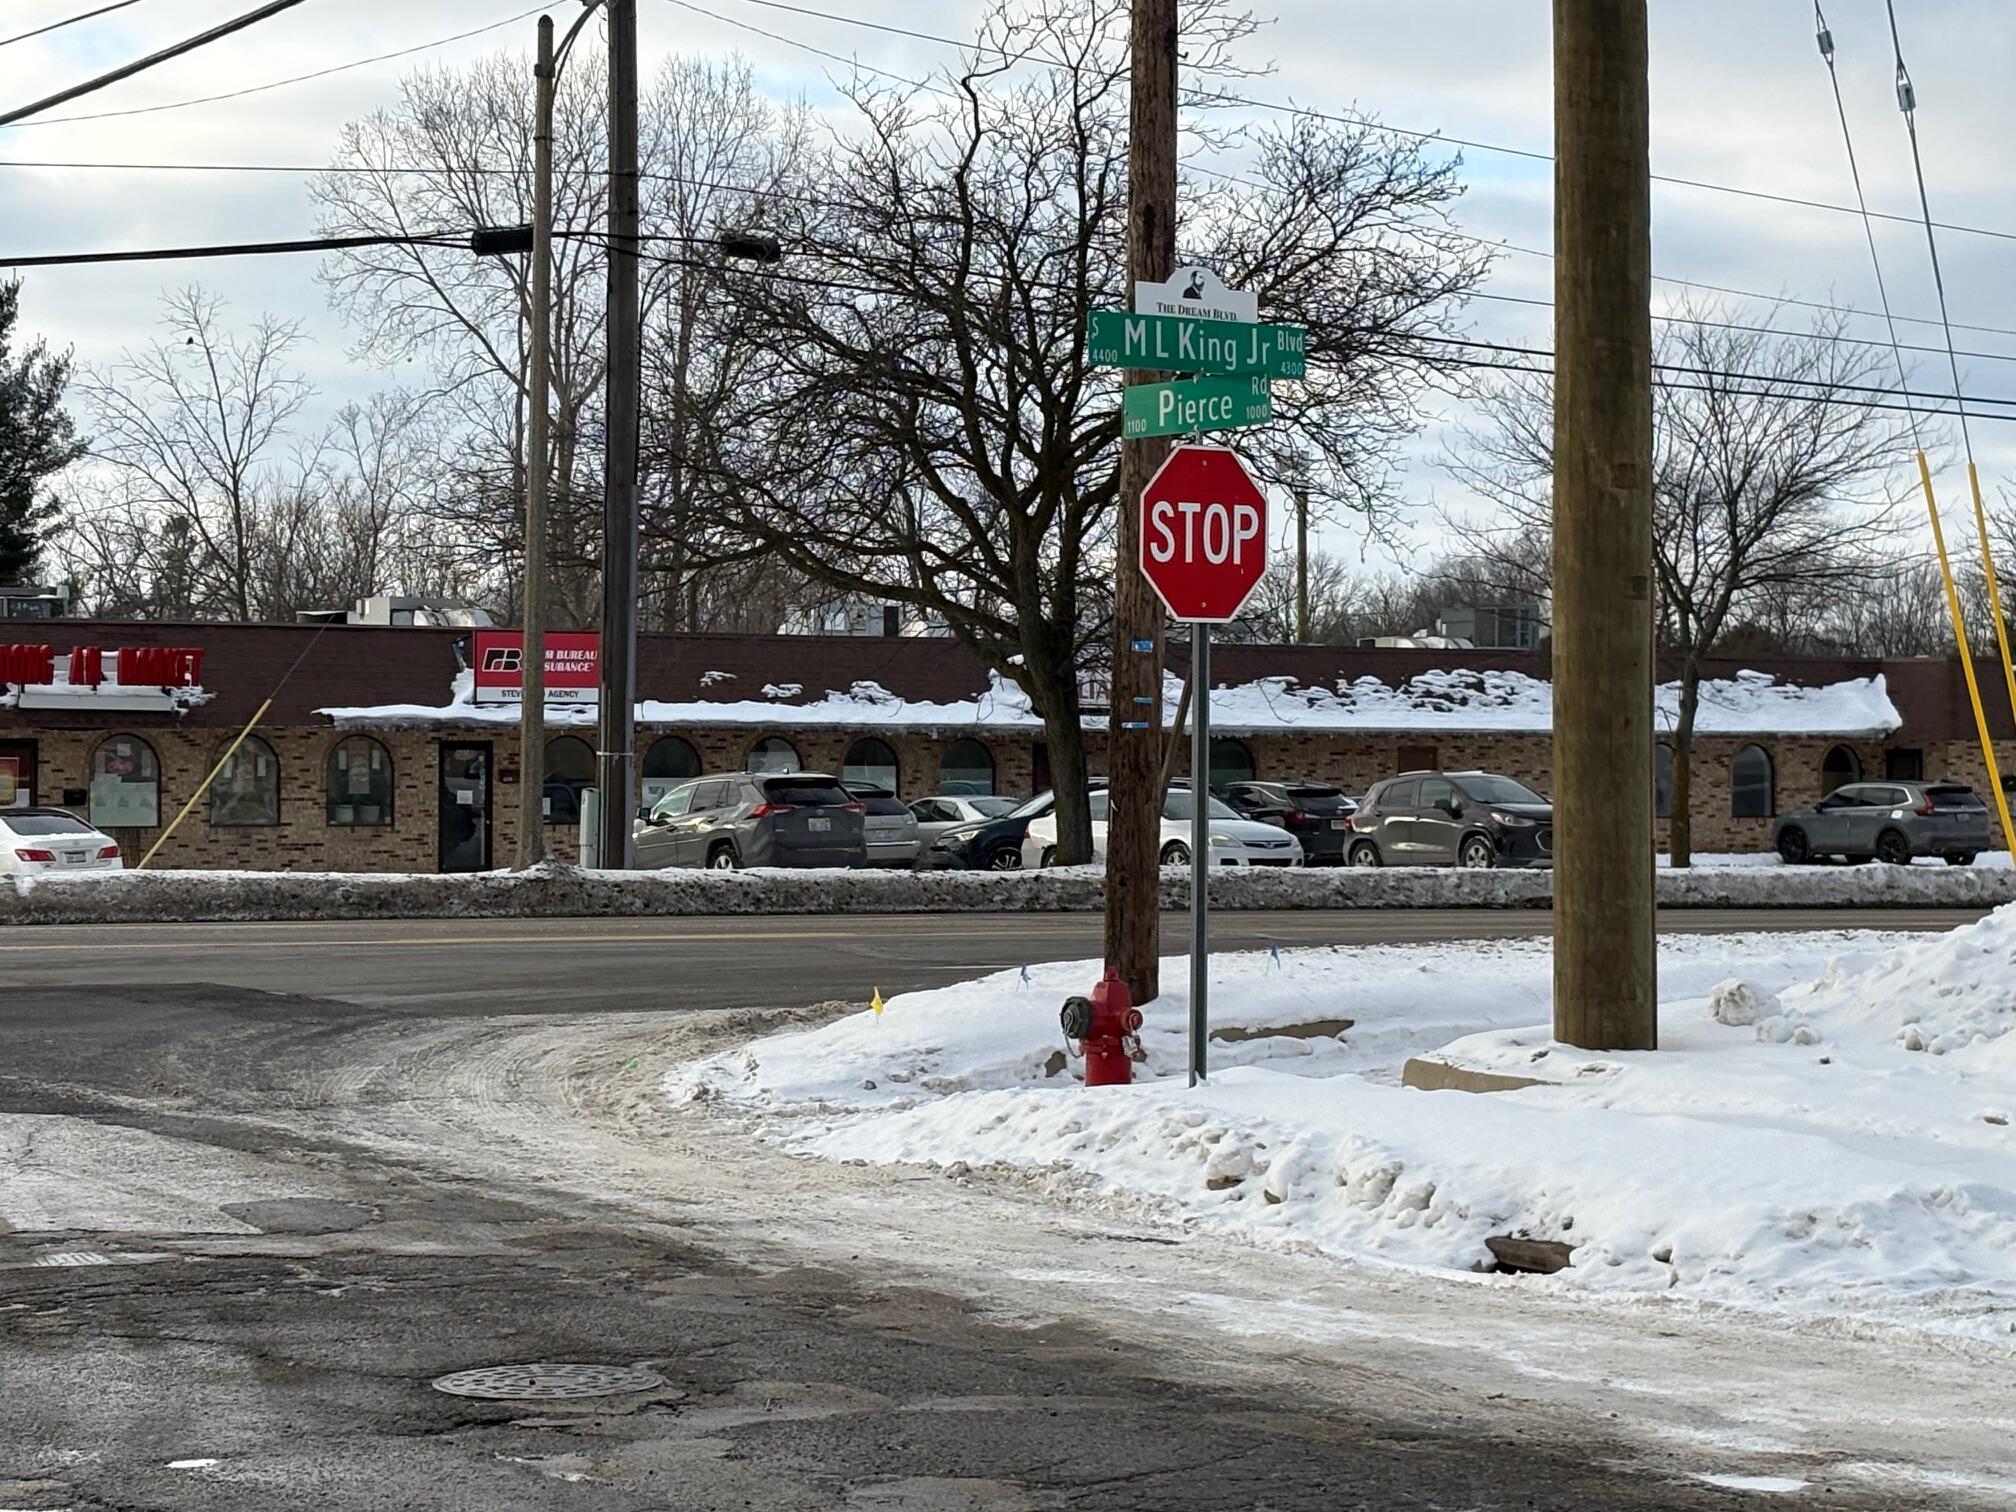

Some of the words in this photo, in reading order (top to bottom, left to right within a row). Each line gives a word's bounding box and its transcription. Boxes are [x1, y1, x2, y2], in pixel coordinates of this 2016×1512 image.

[1156, 302, 1176, 314] THE
[1178, 304, 1210, 319] DREAM
[1178, 322, 1237, 371] King
[1246, 327, 1271, 366] Jr
[1277, 330, 1303, 353] Blvd
[1092, 350, 1118, 363] 4400
[1280, 361, 1303, 376] 4300
[1251, 376, 1267, 396] Rd
[1159, 389, 1233, 427] Pierce
[1246, 405, 1268, 420] 1000
[1150, 500, 1259, 565] STOP
[556, 650, 598, 661] BUREAU
[548, 690, 579, 698] AGENCY
